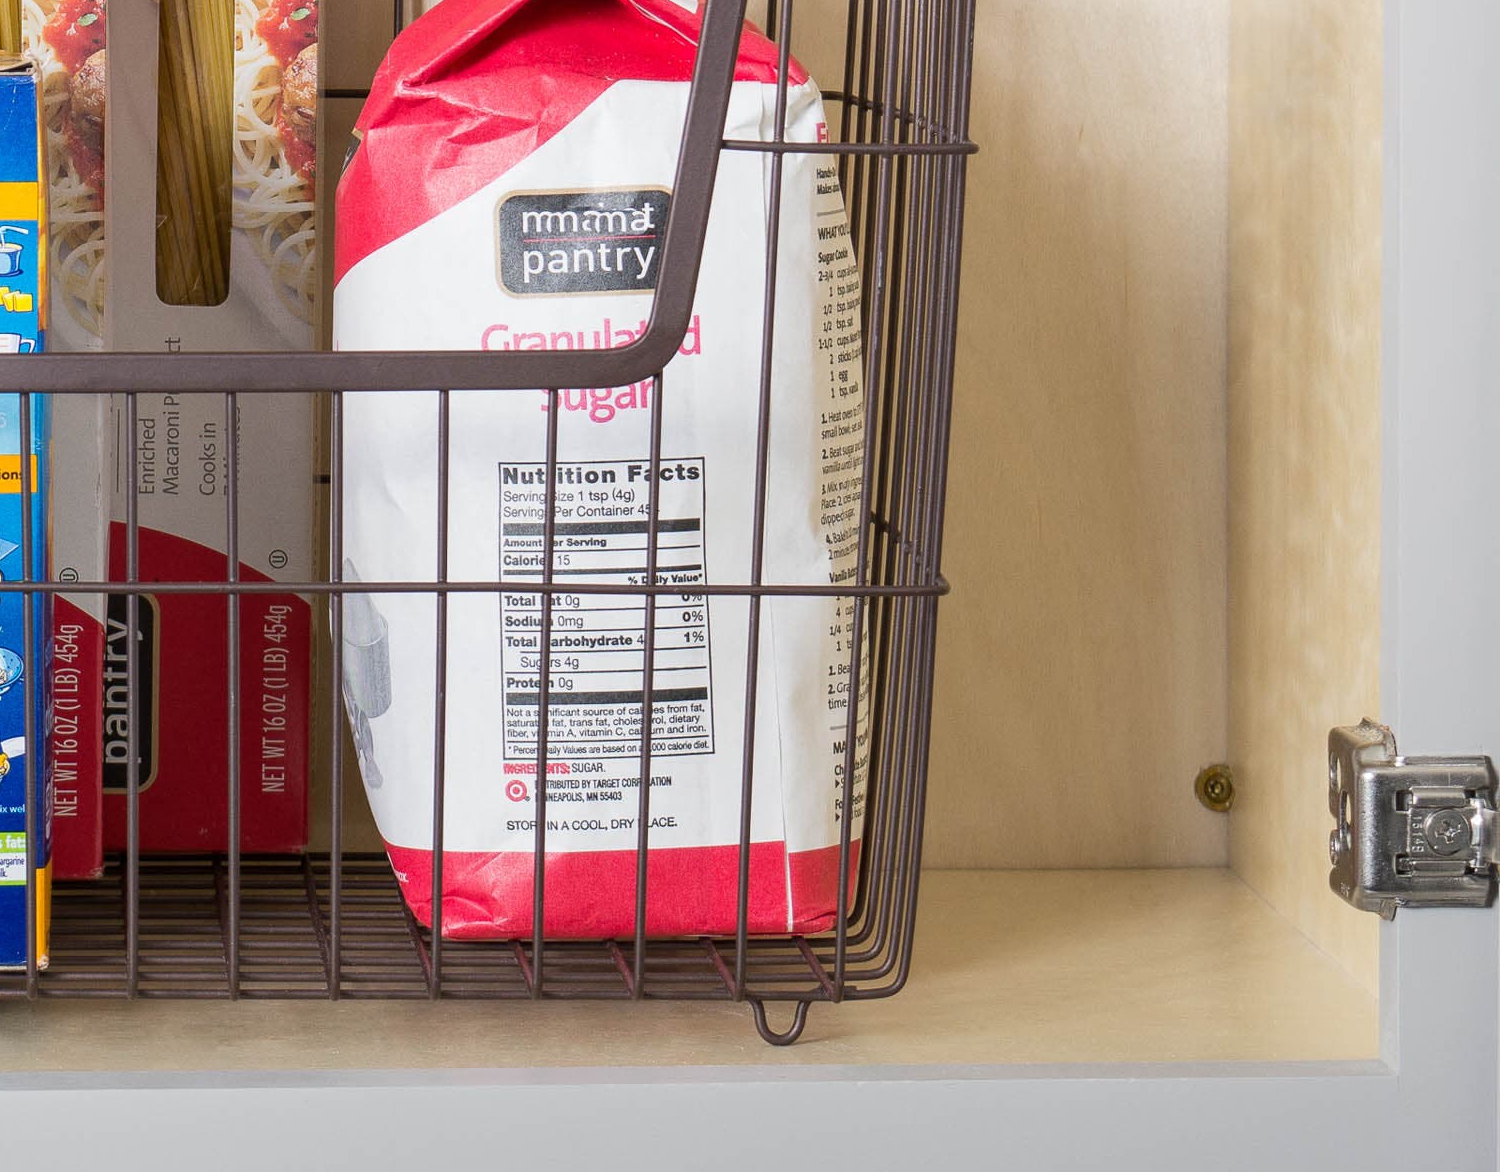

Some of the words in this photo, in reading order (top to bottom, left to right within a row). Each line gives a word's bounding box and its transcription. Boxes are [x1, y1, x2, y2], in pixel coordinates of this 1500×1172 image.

[523, 243, 655, 283] pantry
[481, 315, 701, 355] Granulad
[199, 422, 215, 439] in
[138, 418, 155, 495] Enriched
[163, 411, 180, 495] Macaroni
[199, 443, 215, 496] Cooks
[503, 465, 616, 484] Nutition
[503, 490, 546, 504] Serving
[589, 491, 608, 504] tsp
[612, 488, 635, 503] (4g)
[555, 507, 572, 517] Per
[576, 505, 634, 517] Container
[503, 538, 542, 548] Amount
[566, 538, 607, 548] Serving
[557, 555, 570, 566] 15
[505, 595, 536, 606] Total
[565, 595, 580, 607] 0g
[265, 605, 292, 643] 454g
[557, 616, 583, 628] 0mg
[682, 612, 704, 622] 0%
[55, 624, 83, 663] 454g
[506, 637, 537, 647] Total
[550, 635, 633, 648] arbohydrate
[684, 632, 704, 643] 1%
[264, 647, 290, 673] LB)
[520, 657, 561, 669] Sugrs
[564, 657, 580, 669] 4g
[55, 667, 81, 693] LB)
[558, 678, 573, 690] 0g
[104, 618, 143, 764] pantry
[263, 694, 286, 712] OZ
[506, 708, 523, 717] Not
[582, 708, 614, 716] source
[616, 707, 626, 715] of
[667, 705, 688, 714] from
[55, 714, 78, 734] OZ
[263, 716, 286, 733] 16
[569, 719, 593, 727] trans
[669, 715, 700, 724] dietary
[578, 727, 612, 737] vitamin
[666, 725, 684, 733] and
[686, 723, 706, 733] iron.
[55, 738, 77, 755] 16
[262, 735, 285, 760] WT
[562, 745, 587, 754] Values
[602, 744, 625, 754] based
[627, 745, 636, 753] on
[668, 741, 692, 751] calorie
[54, 759, 77, 782] WT
[571, 763, 606, 773] SUGAR.
[262, 765, 285, 792] NET
[582, 778, 591, 789] BY
[593, 778, 620, 789] TARGET
[54, 788, 77, 816] NET
[586, 792, 599, 802] MN
[600, 791, 622, 801] 55403
[547, 820, 558, 830] IN
[561, 820, 572, 830] A
[572, 819, 608, 831] COOL,
[610, 818, 635, 829] DRY
